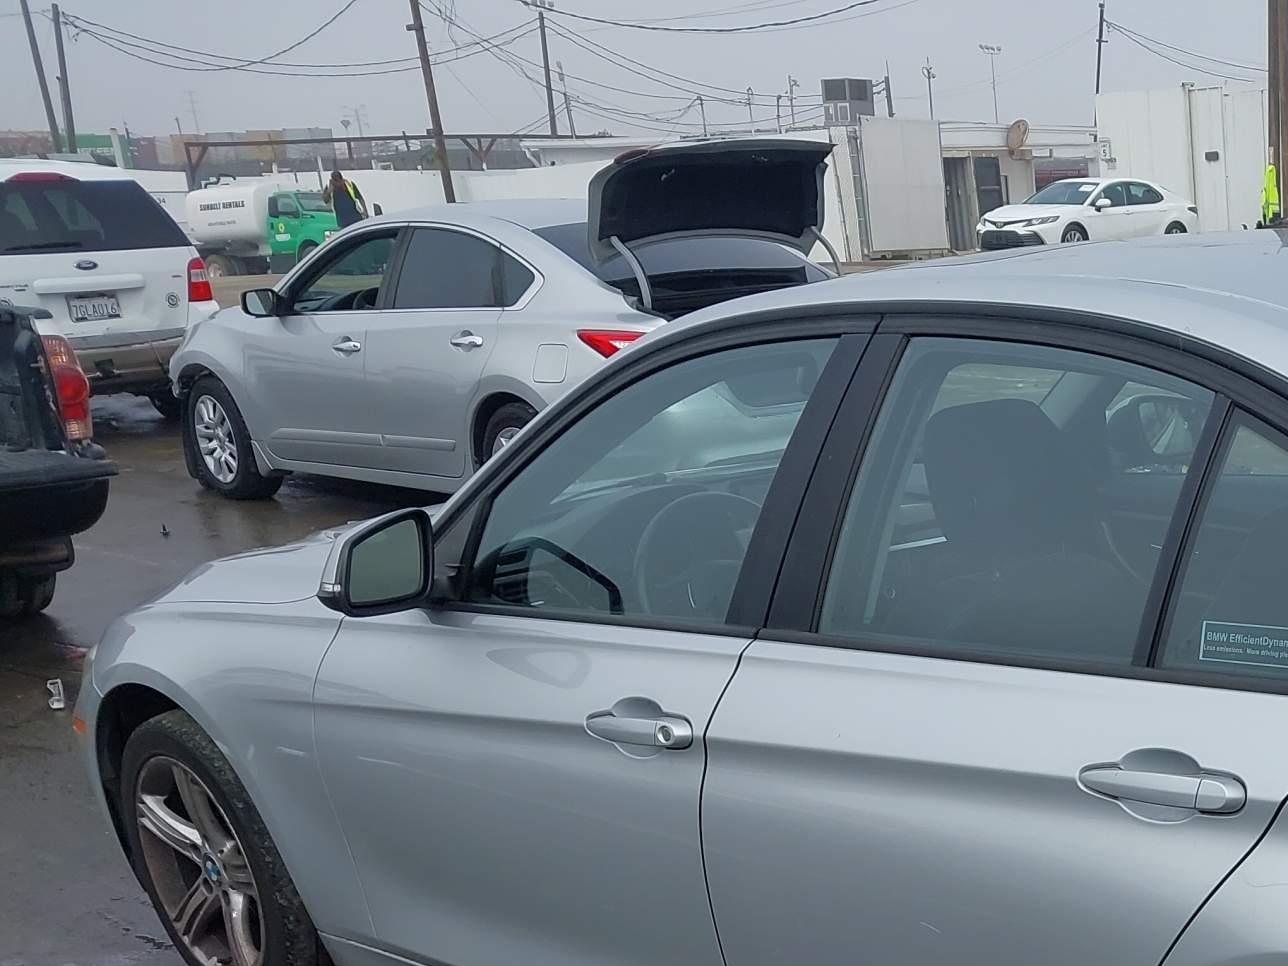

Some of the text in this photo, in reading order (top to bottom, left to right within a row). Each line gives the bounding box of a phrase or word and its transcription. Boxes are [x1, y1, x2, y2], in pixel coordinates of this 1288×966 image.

[200, 200, 245, 212] SUNBELT RENTALS
[72, 304, 116, 317] 7GLA016
[1206, 632, 1228, 642] BMW
[1260, 650, 1278, 658] driving
